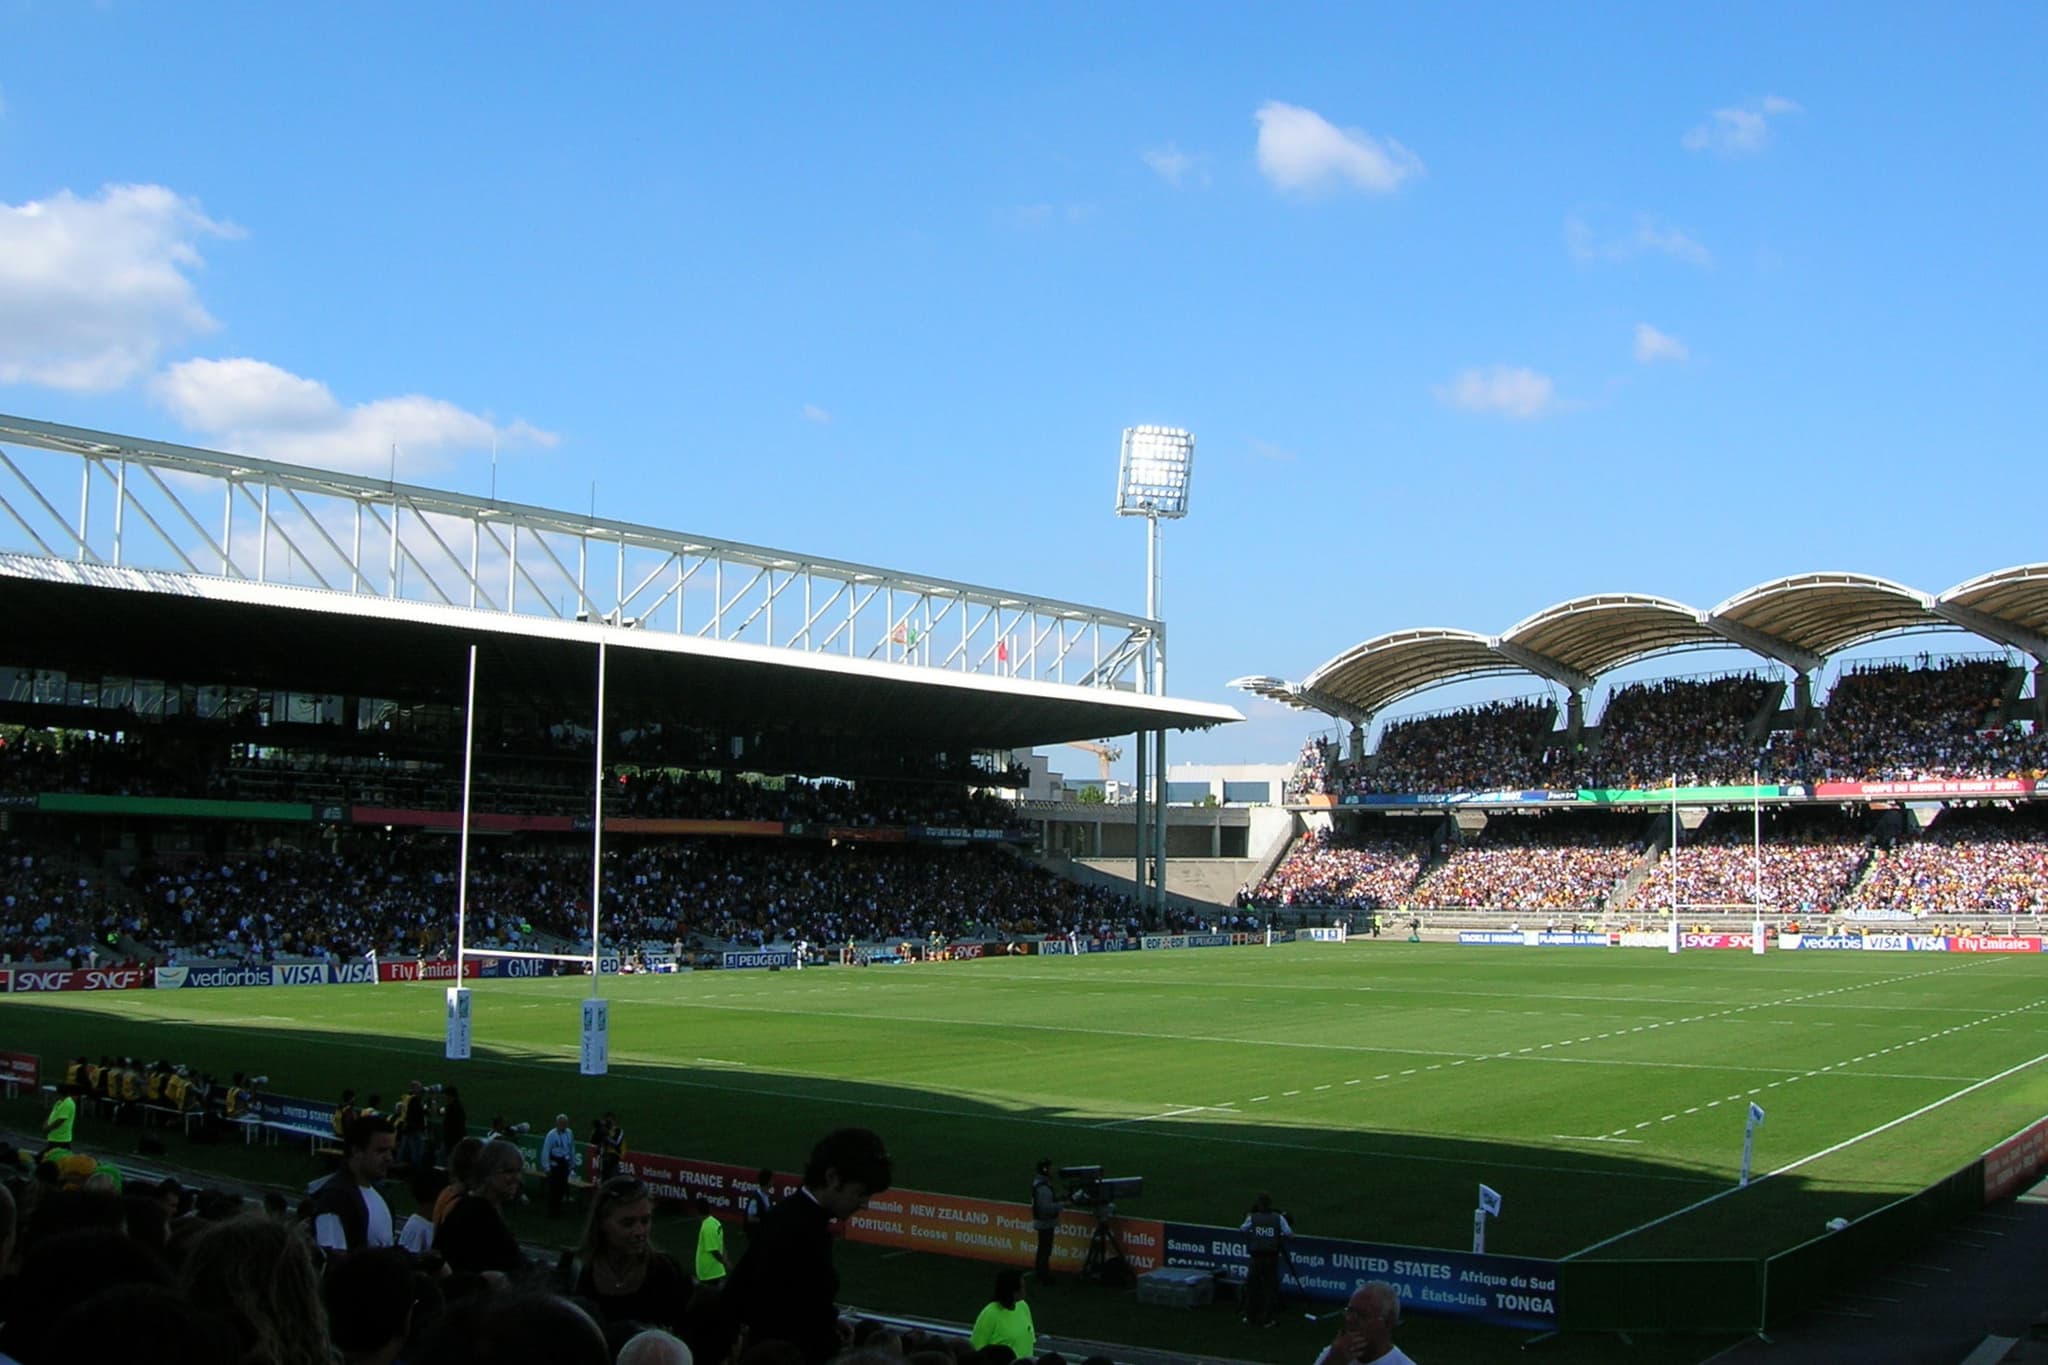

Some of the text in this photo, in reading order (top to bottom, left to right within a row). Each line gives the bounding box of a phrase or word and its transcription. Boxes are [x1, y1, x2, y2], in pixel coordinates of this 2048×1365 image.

[1042, 941, 1066, 954] VISA
[1687, 935, 1722, 948] SNCF
[1727, 935, 1755, 948] SNC
[1803, 935, 1861, 949] vediorbis
[1870, 936, 1902, 950] VISA
[1911, 937, 1947, 951] VISA
[1958, 936, 2030, 951] Fly Emirates
[507, 958, 545, 977] GMF
[739, 954, 787, 966] PEUGEOT
[83, 971, 139, 990] SNCF
[190, 967, 271, 987] vediorbis
[280, 966, 323, 984] VISA
[391, 963, 413, 981] Fly
[16, 972, 74, 991] SNCF
[282, 1104, 308, 1119] UNITED
[679, 1170, 724, 1189] FRANCE
[850, 1216, 904, 1234] PORTUGAL
[955, 1231, 1012, 1249] ROUMANIA
[910, 1203, 935, 1217] NEW
[937, 1207, 989, 1226] ZEALAND
[1122, 1231, 1156, 1247] Italie
[1167, 1239, 1206, 1254] Samoa
[1289, 1251, 1326, 1268] Tonga
[1332, 1252, 1390, 1273] UNITED
[1393, 1259, 1452, 1280] STATES
[1460, 1270, 1508, 1287] Afrique
[1510, 1275, 1527, 1289] du
[1529, 1276, 1556, 1292] Sud
[1421, 1285, 1488, 1307] États-Unis
[1495, 1292, 1556, 1315] TONGA
